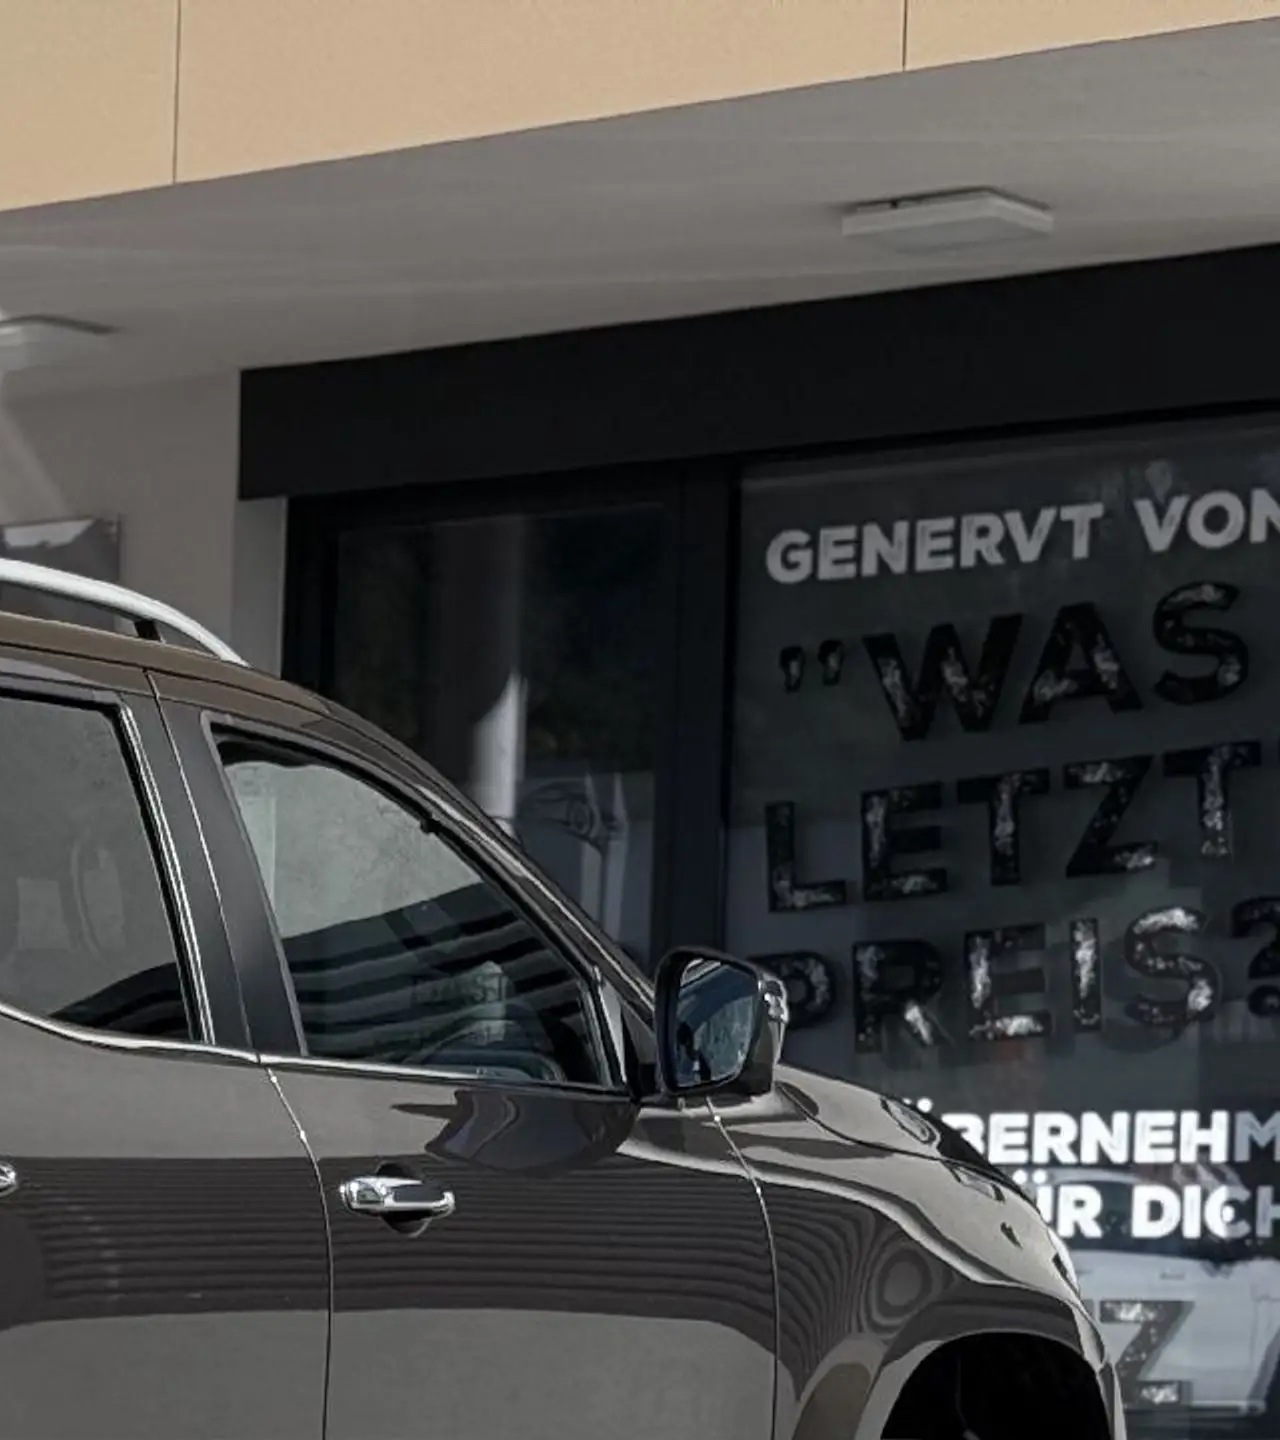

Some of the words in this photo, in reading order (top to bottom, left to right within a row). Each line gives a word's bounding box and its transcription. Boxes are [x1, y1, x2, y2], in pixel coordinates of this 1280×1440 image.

[766, 503, 1103, 584] GENERVT
[1133, 486, 1280, 552] VON
[901, 1098, 1280, 1166] BERNEHM
